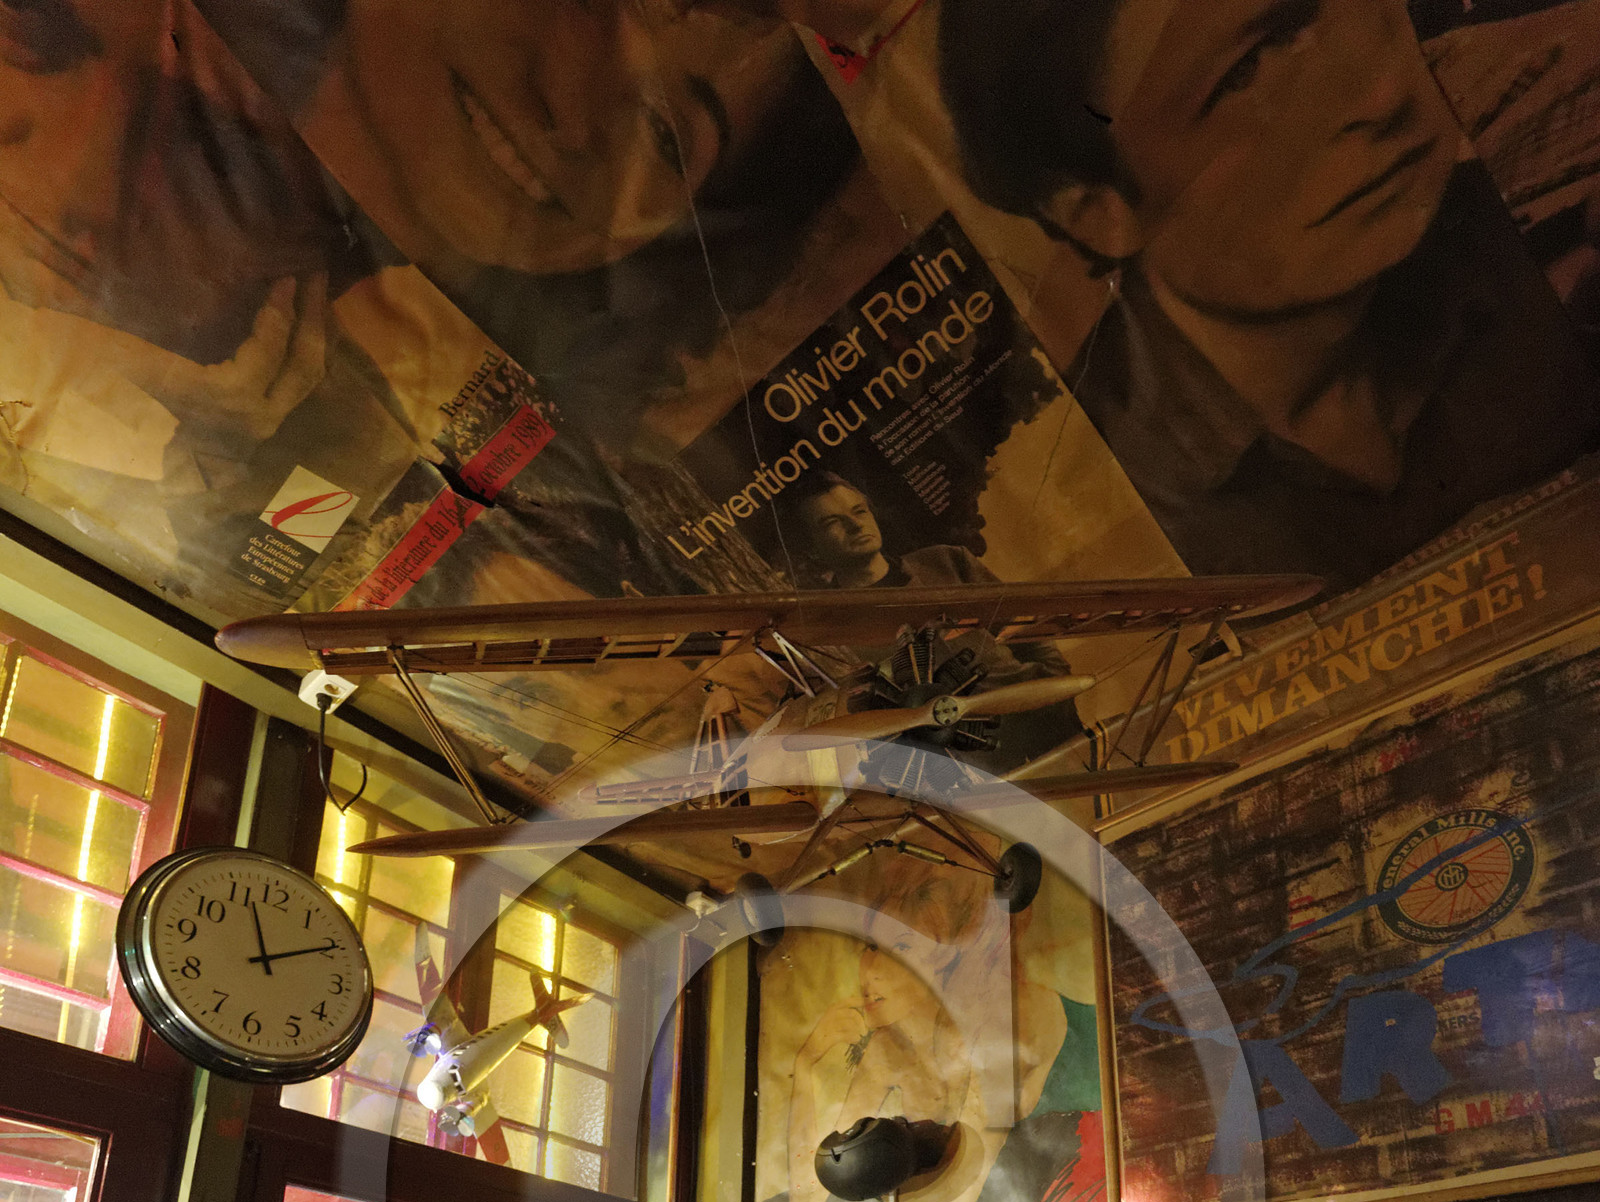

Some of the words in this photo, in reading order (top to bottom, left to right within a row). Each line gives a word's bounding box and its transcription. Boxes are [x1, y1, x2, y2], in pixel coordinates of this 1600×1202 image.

[763, 326, 867, 424] Olivier
[861, 247, 967, 341] Rolin
[438, 350, 501, 418] Bernard
[929, 374, 953, 394] Olivier
[511, 412, 548, 448] 1989
[667, 436, 821, 560] L'invention
[819, 398, 868, 447] du
[863, 289, 994, 409] monde
[1171, 530, 1520, 729] VIVEMENT
[1436, 811, 1497, 830] Mills
[229, 881, 250, 908] 11
[261, 884, 290, 913] 12
[196, 895, 226, 923] 10
[302, 908, 312, 929] 1
[177, 918, 197, 943] 9
[319, 937, 337, 960] 2
[180, 955, 201, 980] 8
[327, 974, 344, 995] 3
[210, 989, 230, 1013] 7
[310, 1000, 328, 1021] 4
[242, 1010, 262, 1036] 6
[284, 1014, 302, 1038] 5
